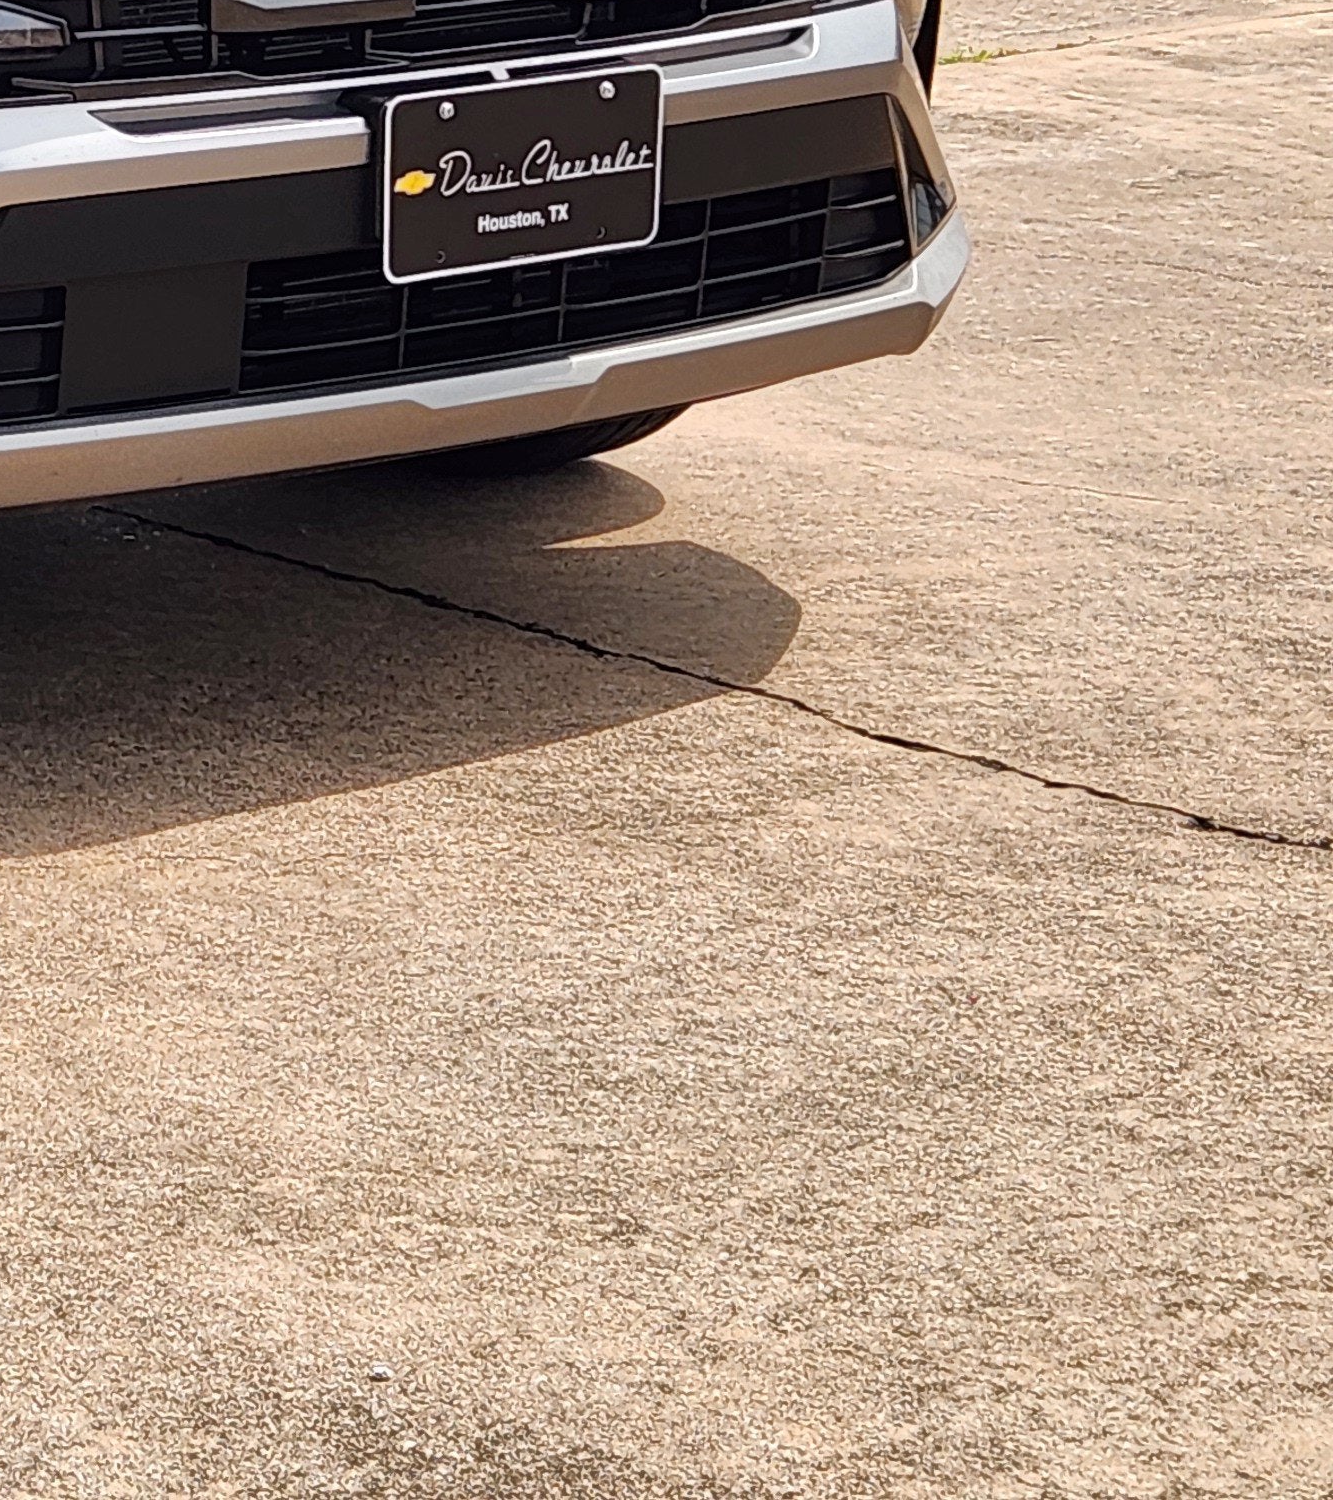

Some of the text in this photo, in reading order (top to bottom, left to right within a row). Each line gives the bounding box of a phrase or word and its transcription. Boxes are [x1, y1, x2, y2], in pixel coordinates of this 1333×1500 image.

[439, 139, 655, 197] Davis Chevrolet
[477, 202, 570, 233] Houston, TX
